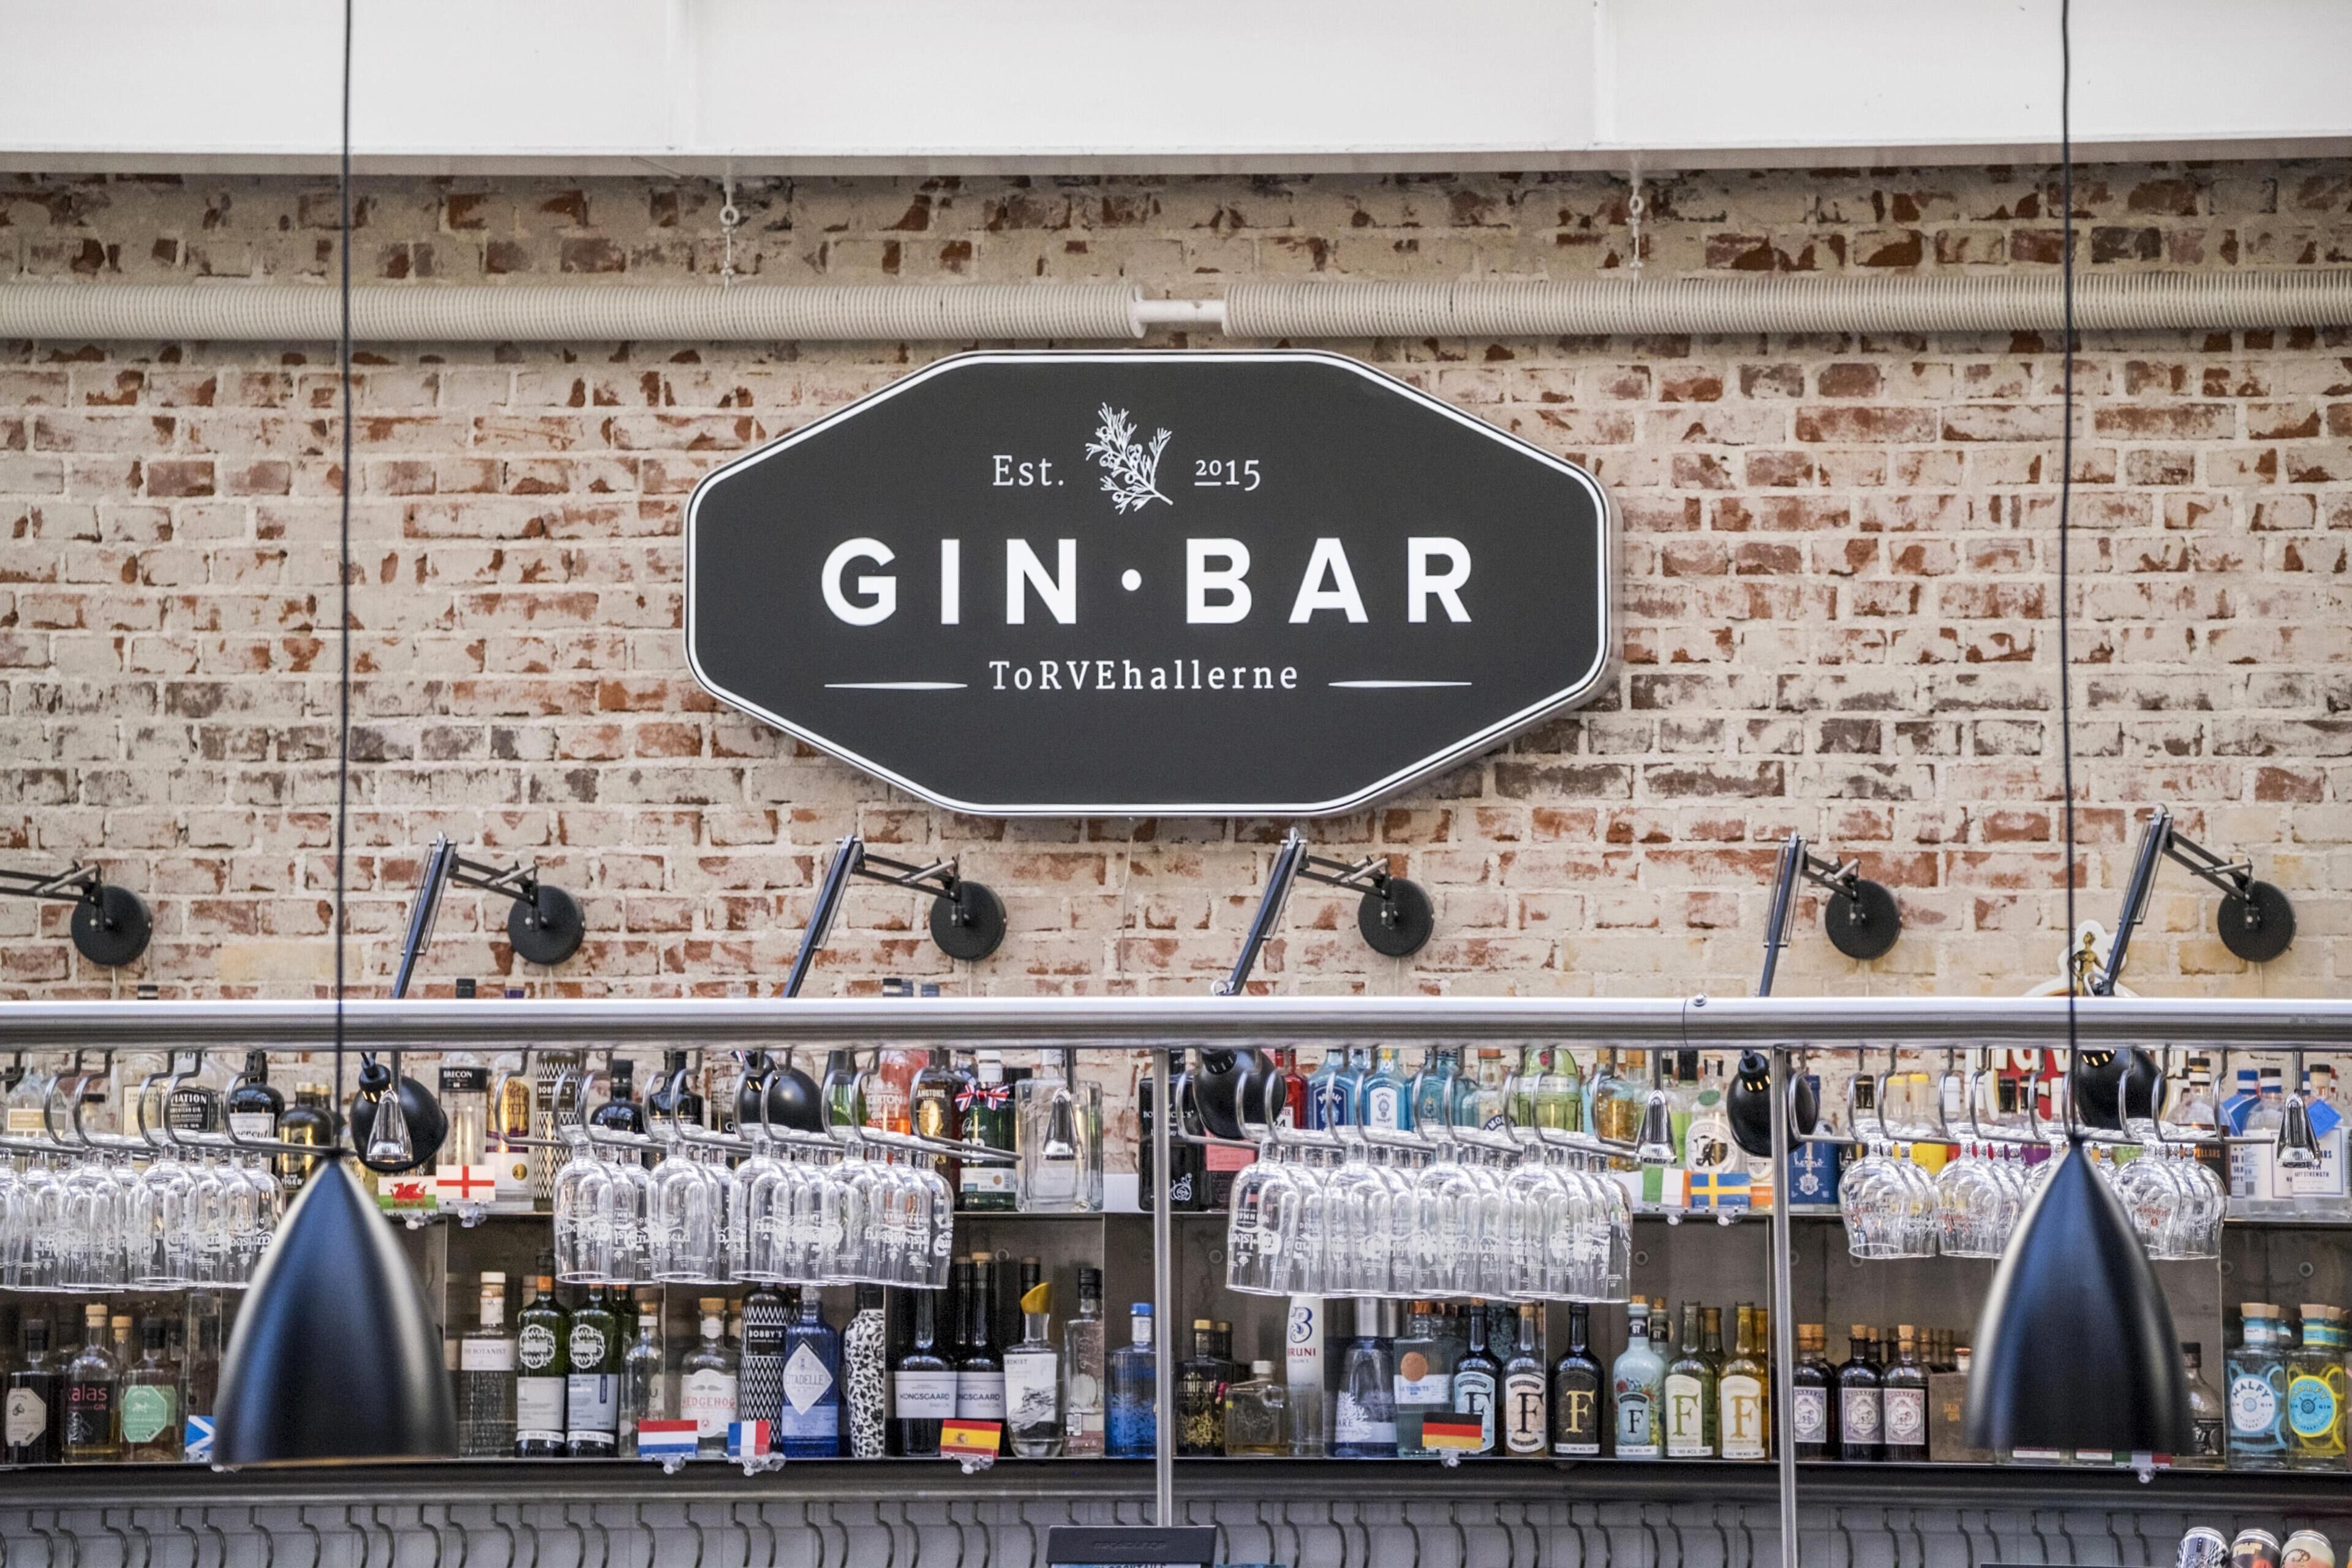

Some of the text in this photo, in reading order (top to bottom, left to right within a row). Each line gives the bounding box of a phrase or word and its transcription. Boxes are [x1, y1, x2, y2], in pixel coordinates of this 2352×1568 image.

[992, 454, 1261, 491] Est. 2015
[821, 537, 1472, 627] GIN BAR
[989, 659, 1298, 690] ToRVEhallerne
[916, 1089, 946, 1098] ANGTONS
[2194, 1147, 2221, 1158] PILLARS
[748, 1329, 783, 1338] BOBBY'S
[2233, 1381, 2271, 1398] MALFY
[2291, 1381, 2329, 1400] MALFY
[1337, 1419, 1353, 1427] ARE
[1516, 1391, 1545, 1434] F
[1566, 1390, 1595, 1433] F
[1627, 1409, 1644, 1434] F
[1672, 1393, 1699, 1437] F
[1730, 1393, 1760, 1439] F
